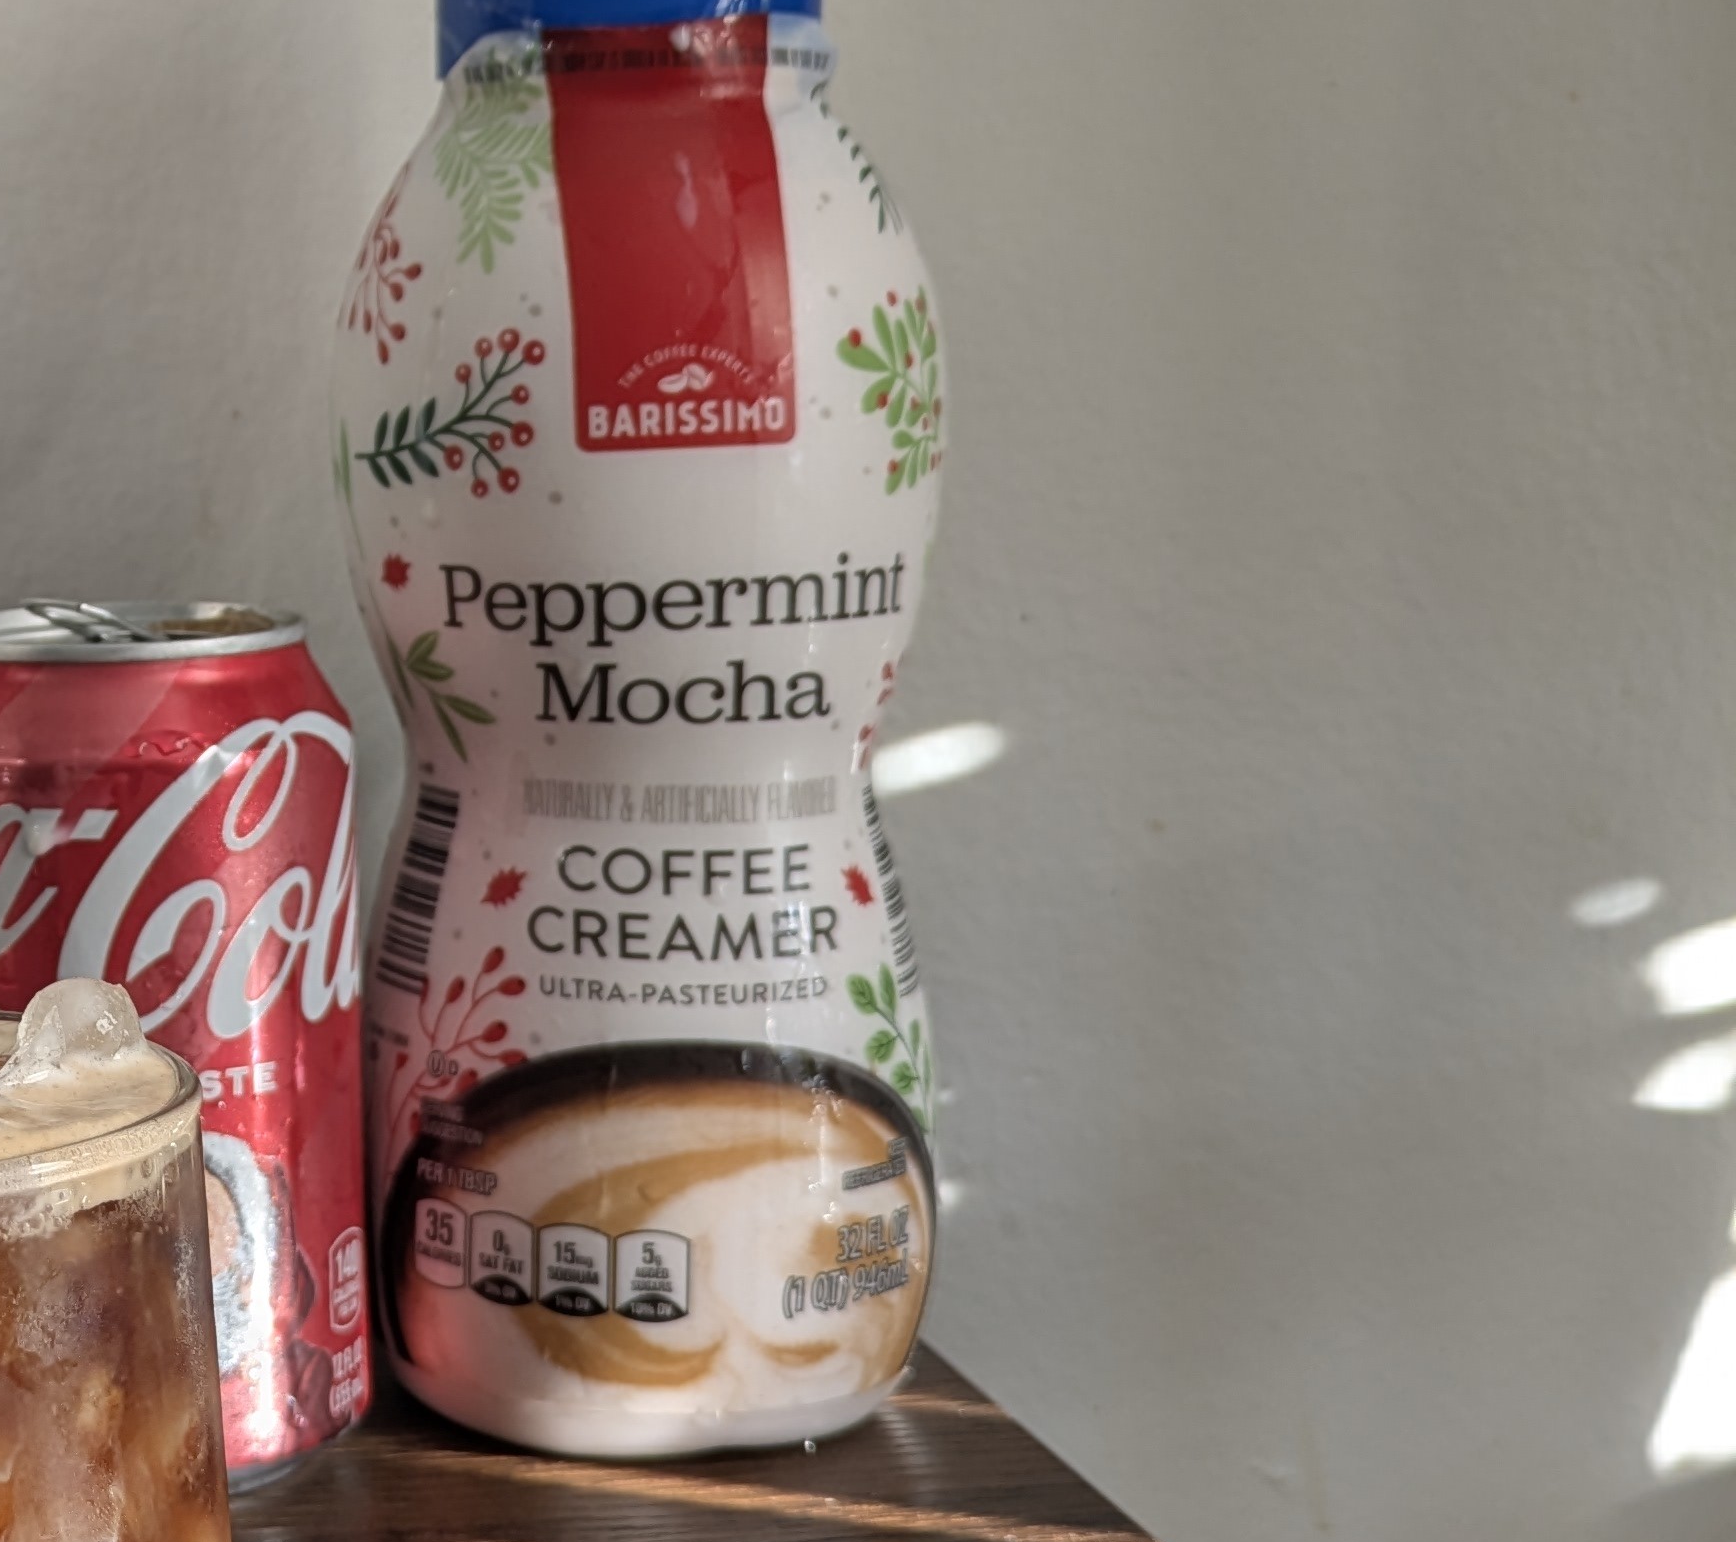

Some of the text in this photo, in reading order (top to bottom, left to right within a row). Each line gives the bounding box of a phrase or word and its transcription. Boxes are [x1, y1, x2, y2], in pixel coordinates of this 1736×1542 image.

[587, 396, 786, 439] BARISSIMO
[439, 552, 905, 647] Peppermint
[535, 659, 832, 724] Mocha
[640, 784, 759, 823] ARTIFICIALLY
[558, 844, 811, 896] COFFEE
[527, 905, 839, 961] CREAMER
[539, 974, 829, 1006] ULTRA-PASTEURIZED
[425, 1208, 454, 1246] 35
[836, 1223, 863, 1263] 32
[865, 1214, 886, 1257] FL
[811, 1267, 850, 1312] QT)
